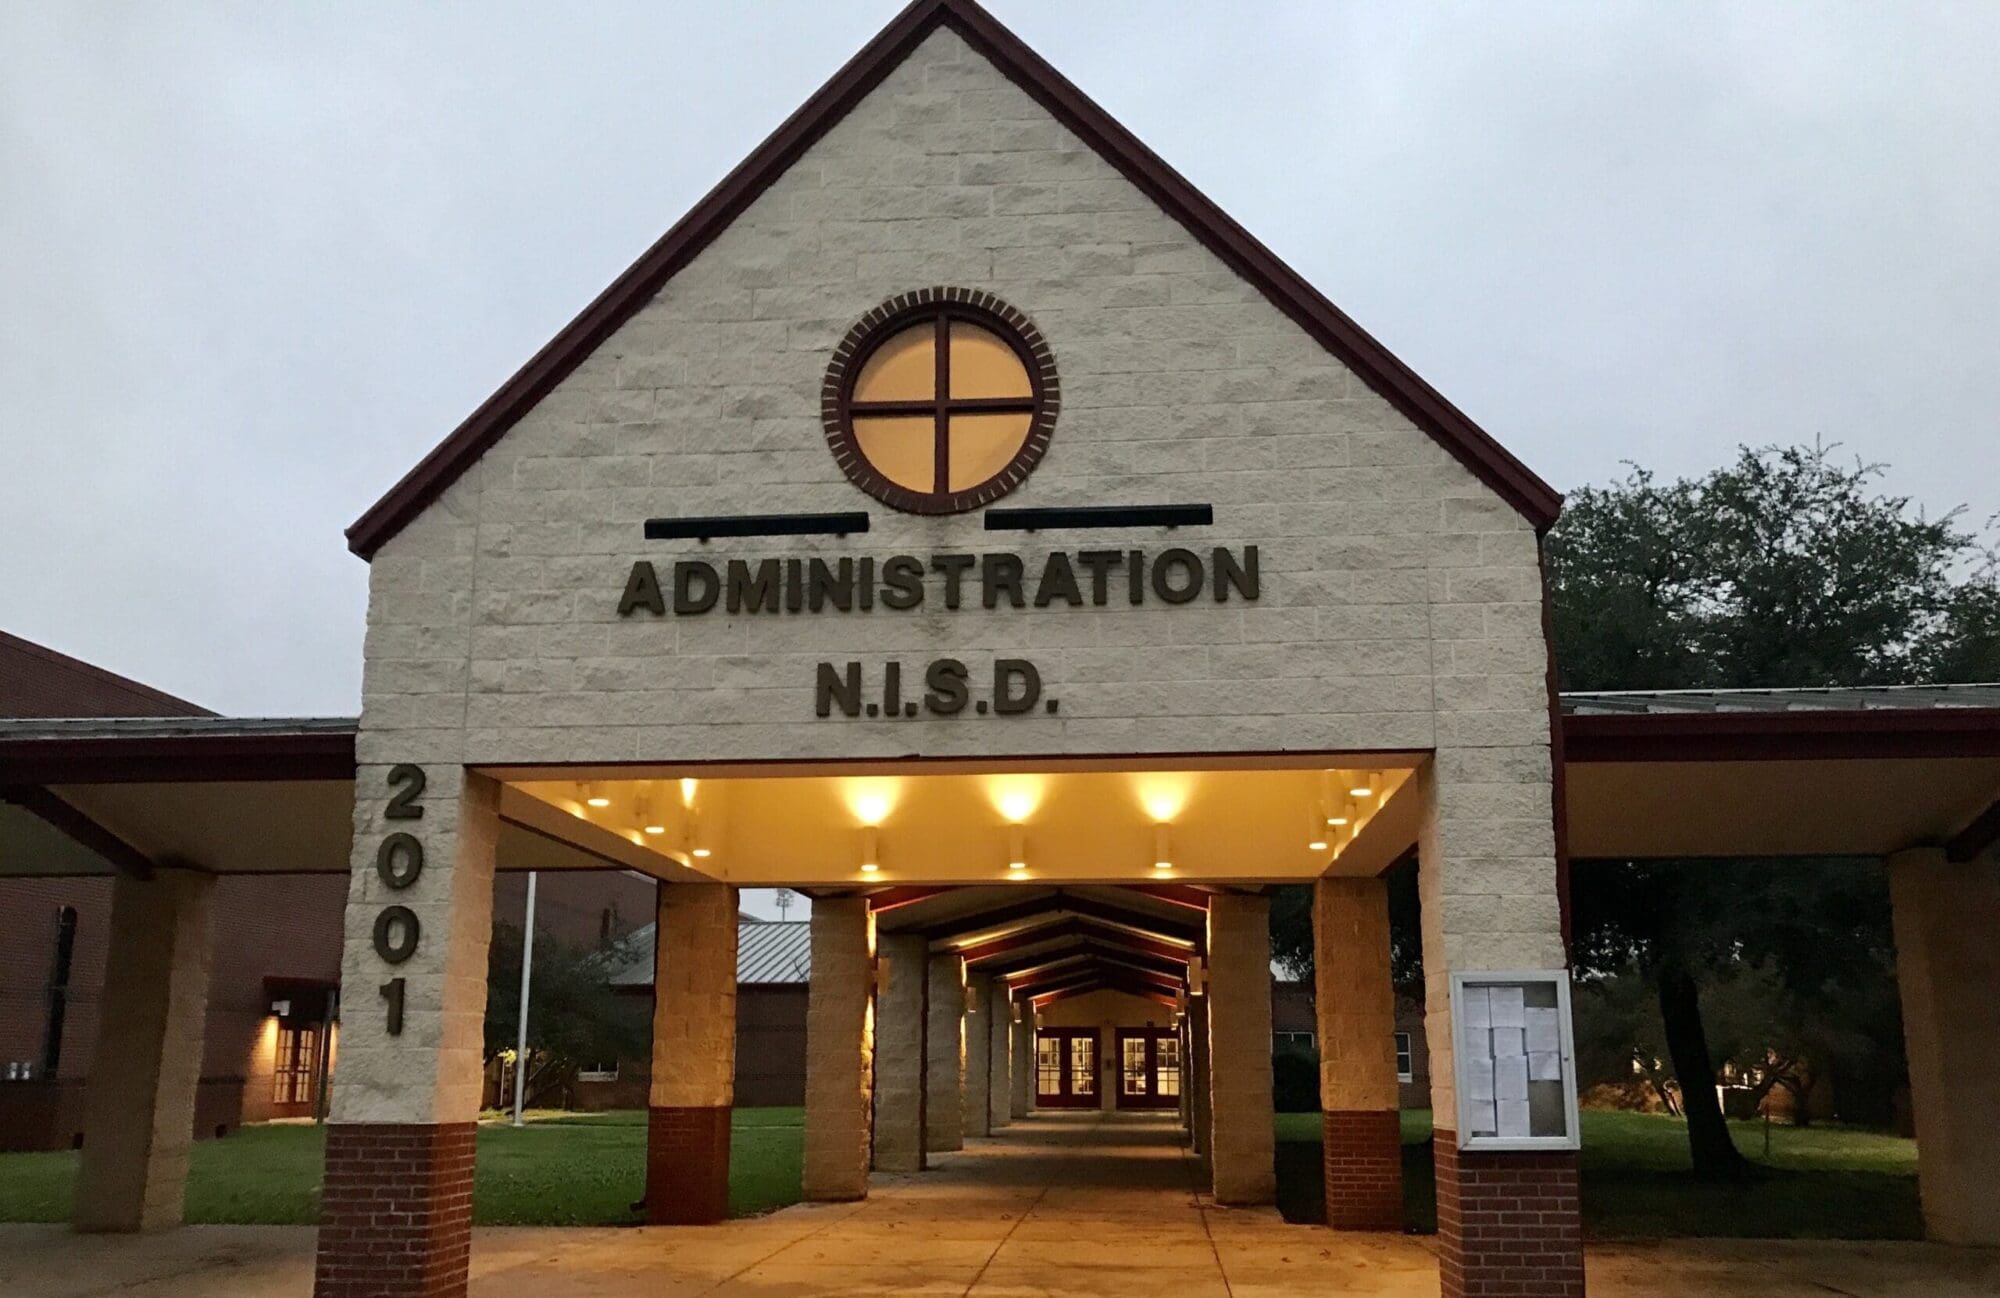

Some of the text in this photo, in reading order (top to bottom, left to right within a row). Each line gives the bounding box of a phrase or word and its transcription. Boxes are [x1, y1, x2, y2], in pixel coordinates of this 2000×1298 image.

[617, 545, 1260, 614] ADMINISTRATION
[816, 659, 1059, 717] N.I.S.D.
[373, 763, 426, 1036] 2001
